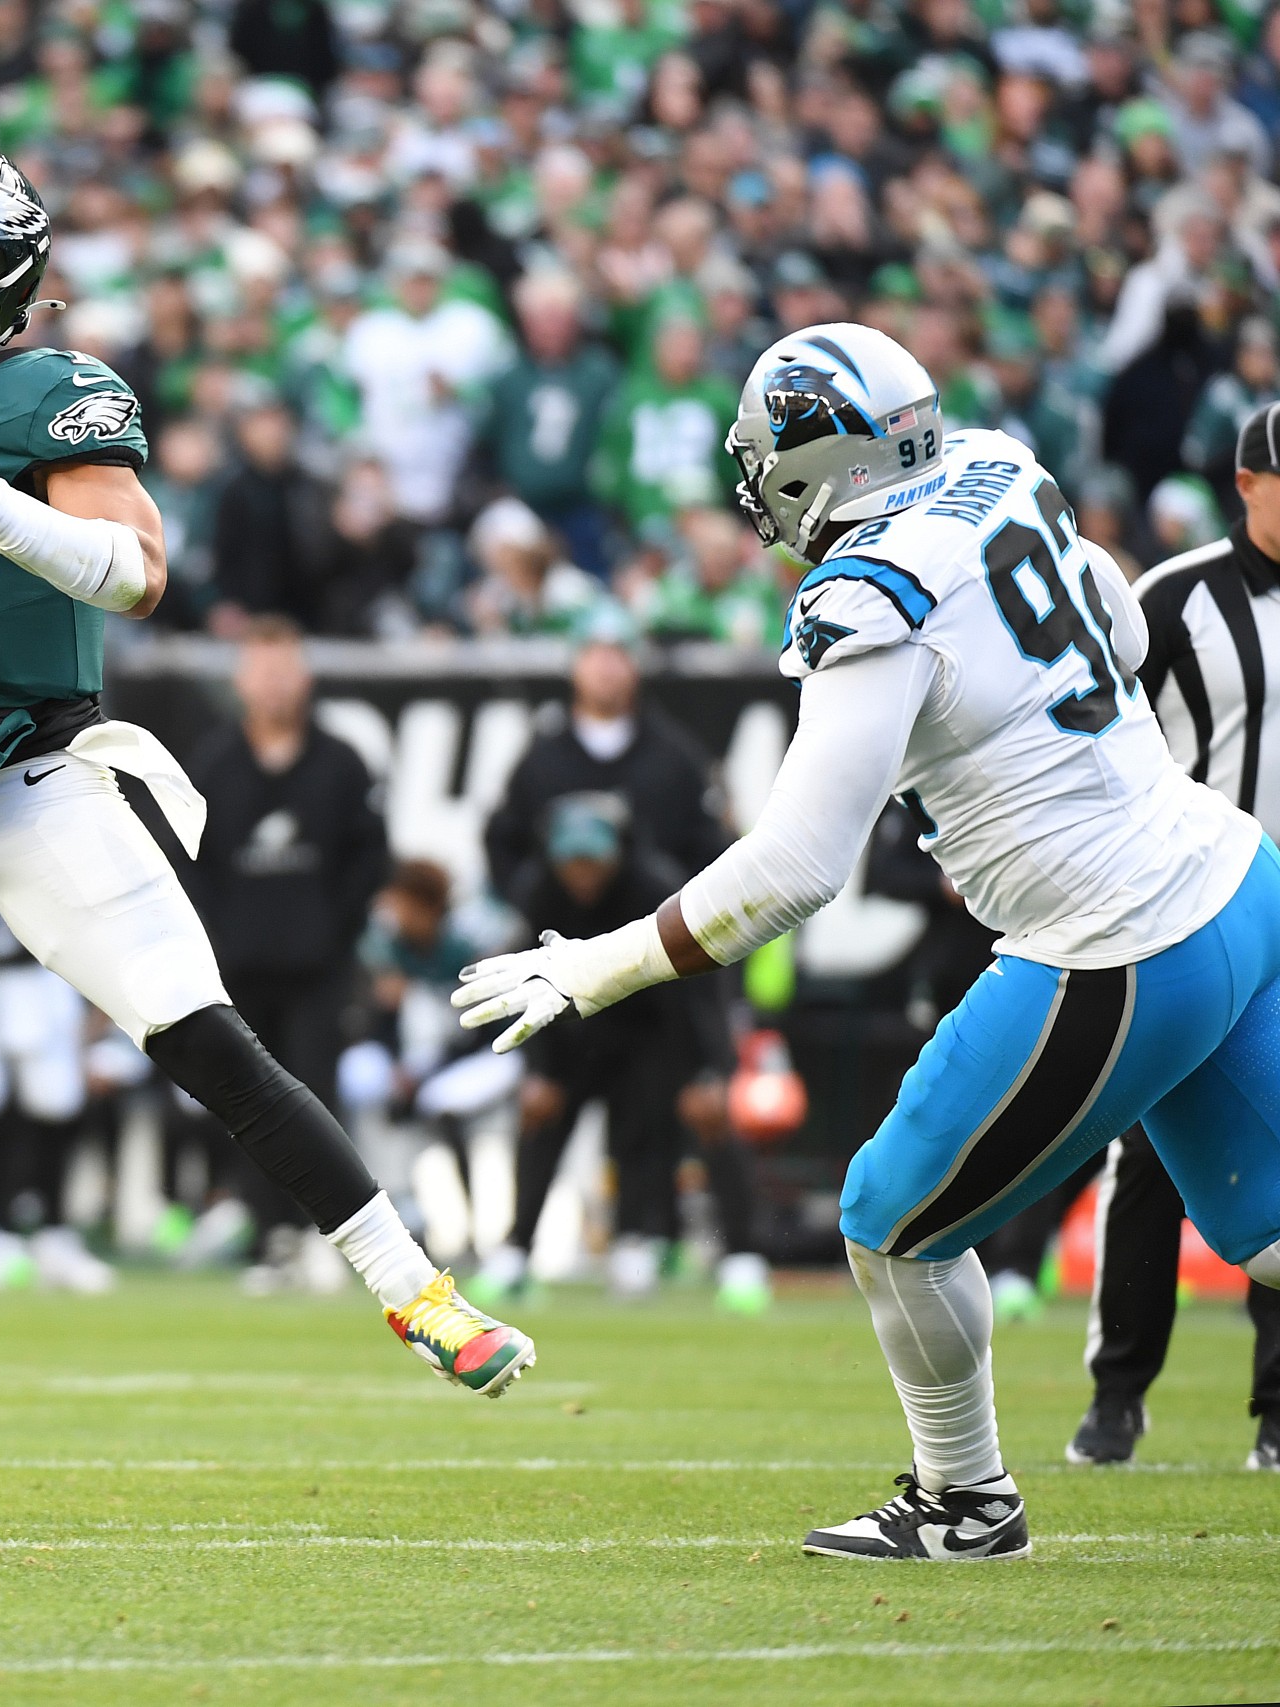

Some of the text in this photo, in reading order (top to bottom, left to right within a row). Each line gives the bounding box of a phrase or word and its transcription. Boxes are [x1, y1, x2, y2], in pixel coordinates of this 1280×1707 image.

[884, 471, 947, 511] PANTHER
[924, 460, 1022, 528] HARRIS
[981, 475, 1140, 740] 92
